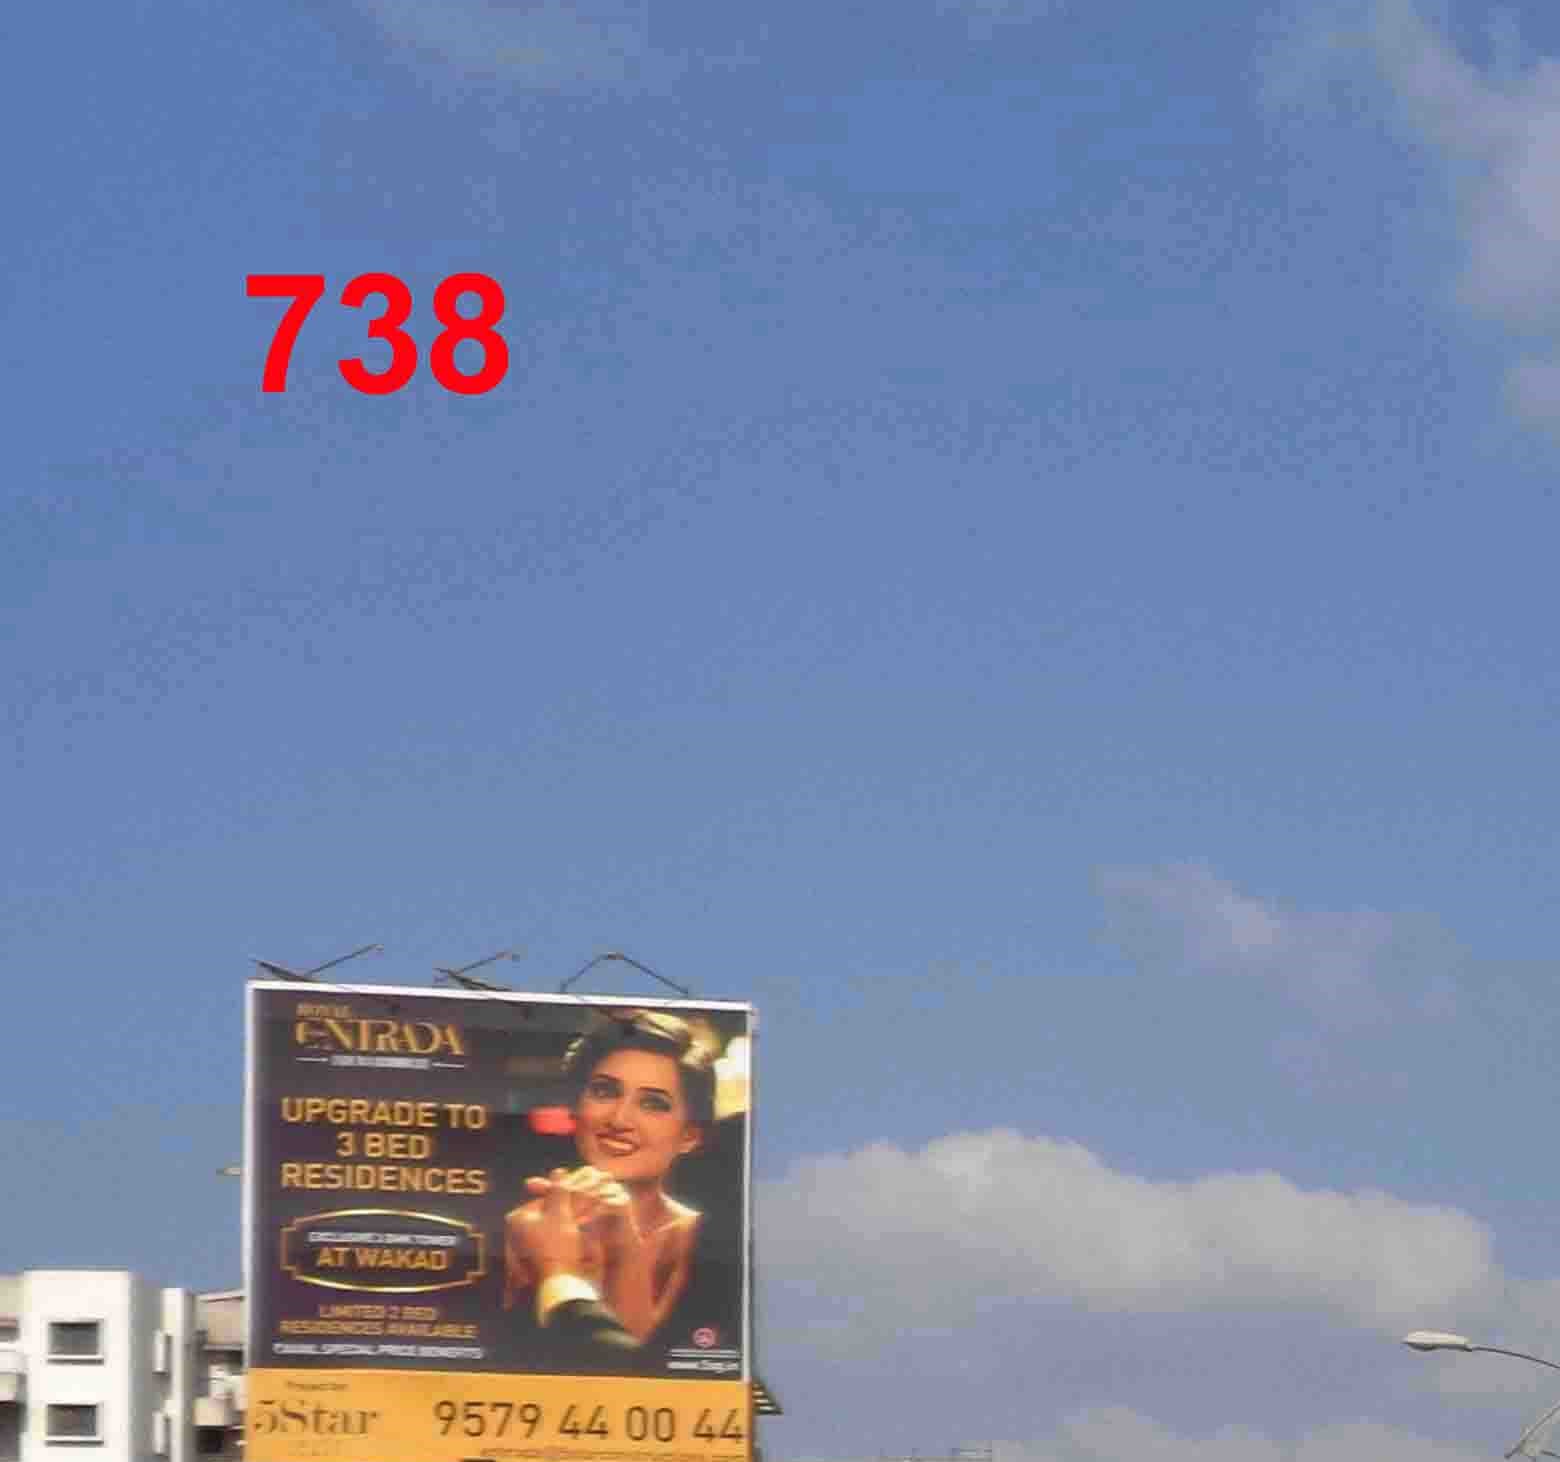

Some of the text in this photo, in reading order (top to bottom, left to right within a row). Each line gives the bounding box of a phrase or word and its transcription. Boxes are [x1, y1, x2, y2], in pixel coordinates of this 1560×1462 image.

[281, 1098, 488, 1129] UPGRADE TO
[336, 1131, 431, 1160] 3 BED
[281, 1162, 487, 1194] RESIDENCES
[317, 1247, 448, 1271] AT WAKAD
[280, 1320, 384, 1335] RESIDENCES
[254, 1400, 379, 1433] 5Star
[434, 1400, 744, 1443] 9579 44 00 44
